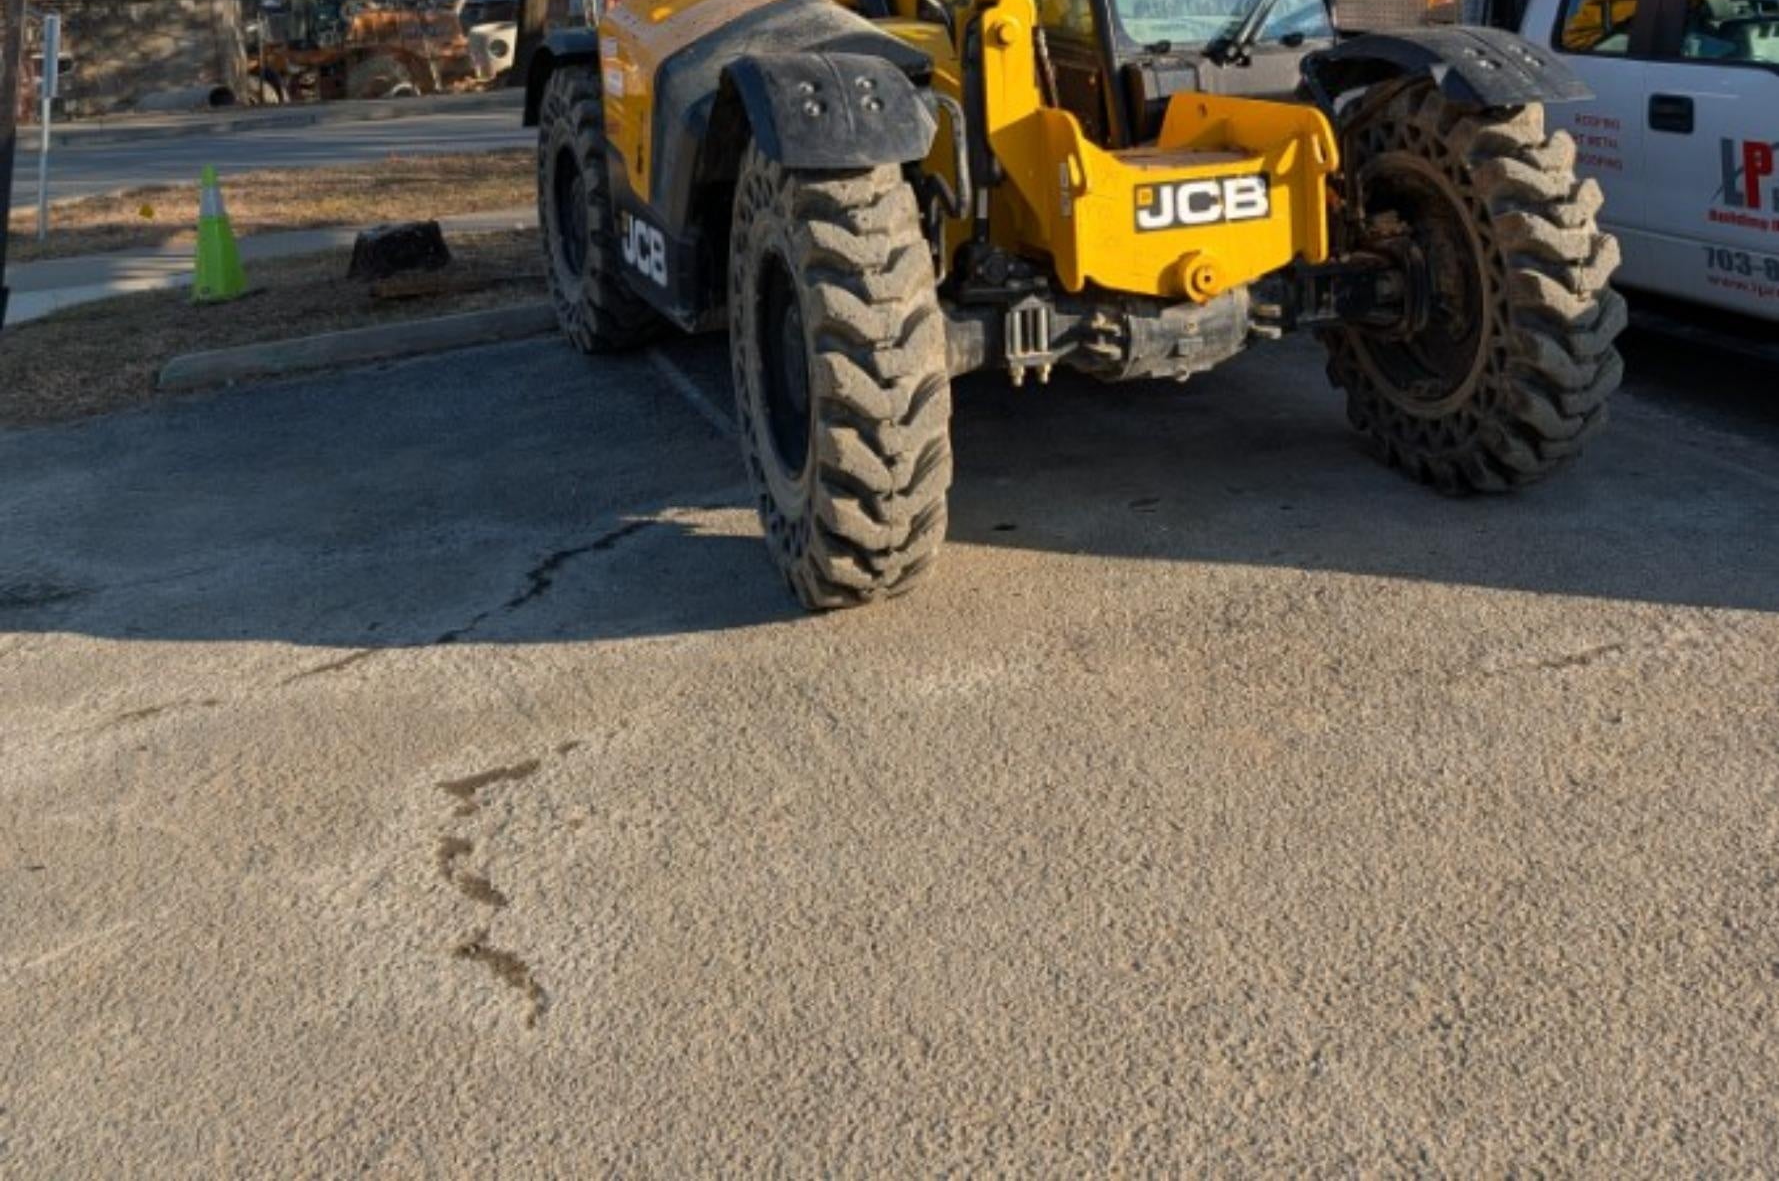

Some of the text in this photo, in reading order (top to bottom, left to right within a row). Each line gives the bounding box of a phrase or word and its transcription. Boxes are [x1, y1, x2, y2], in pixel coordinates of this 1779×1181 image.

[1136, 176, 1269, 230] JCB
[1719, 137, 1779, 212] LP
[621, 213, 668, 288] JCB
